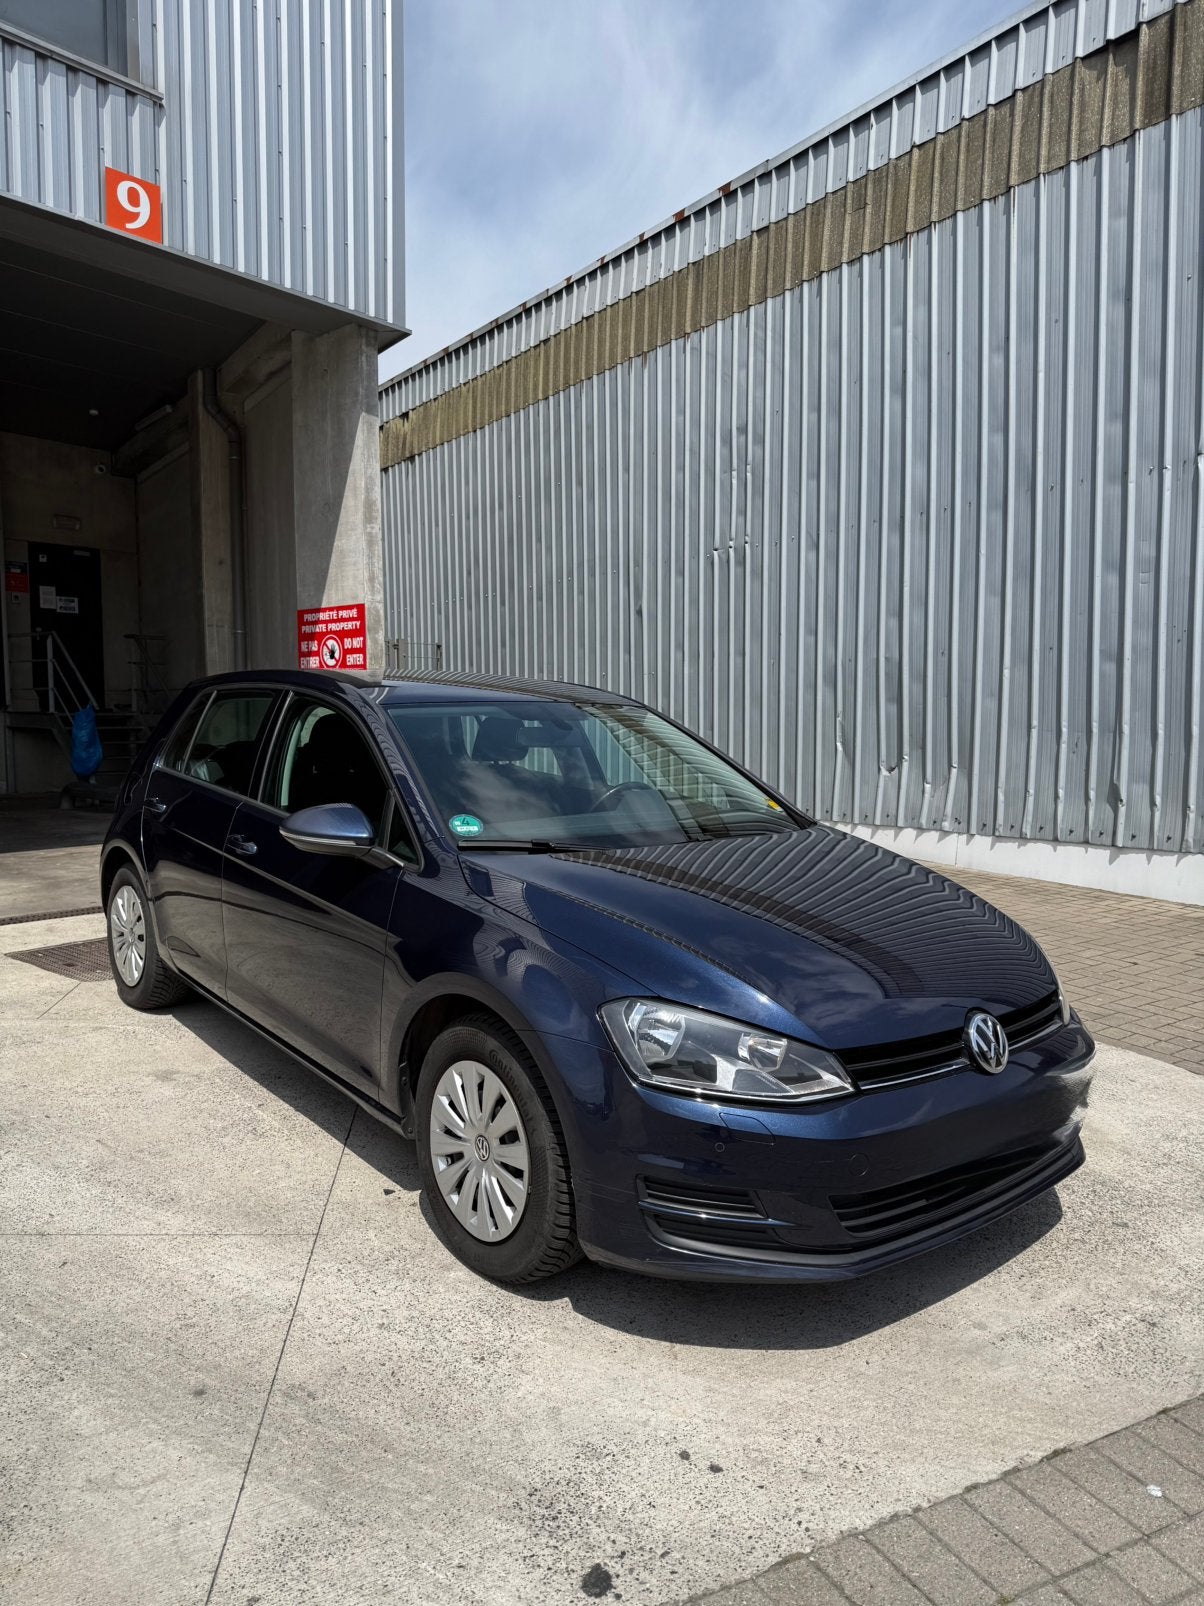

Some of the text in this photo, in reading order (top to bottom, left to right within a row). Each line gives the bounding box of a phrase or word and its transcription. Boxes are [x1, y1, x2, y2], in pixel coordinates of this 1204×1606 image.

[117, 181, 150, 229] 9
[303, 607, 358, 622] PROPRIÉTÉ PRIVÉ
[302, 620, 361, 634] PRIVATE PROPERTY
[344, 636, 364, 649] DO NOT
[300, 656, 320, 669] ENTRER
[346, 653, 364, 666] ENTER
